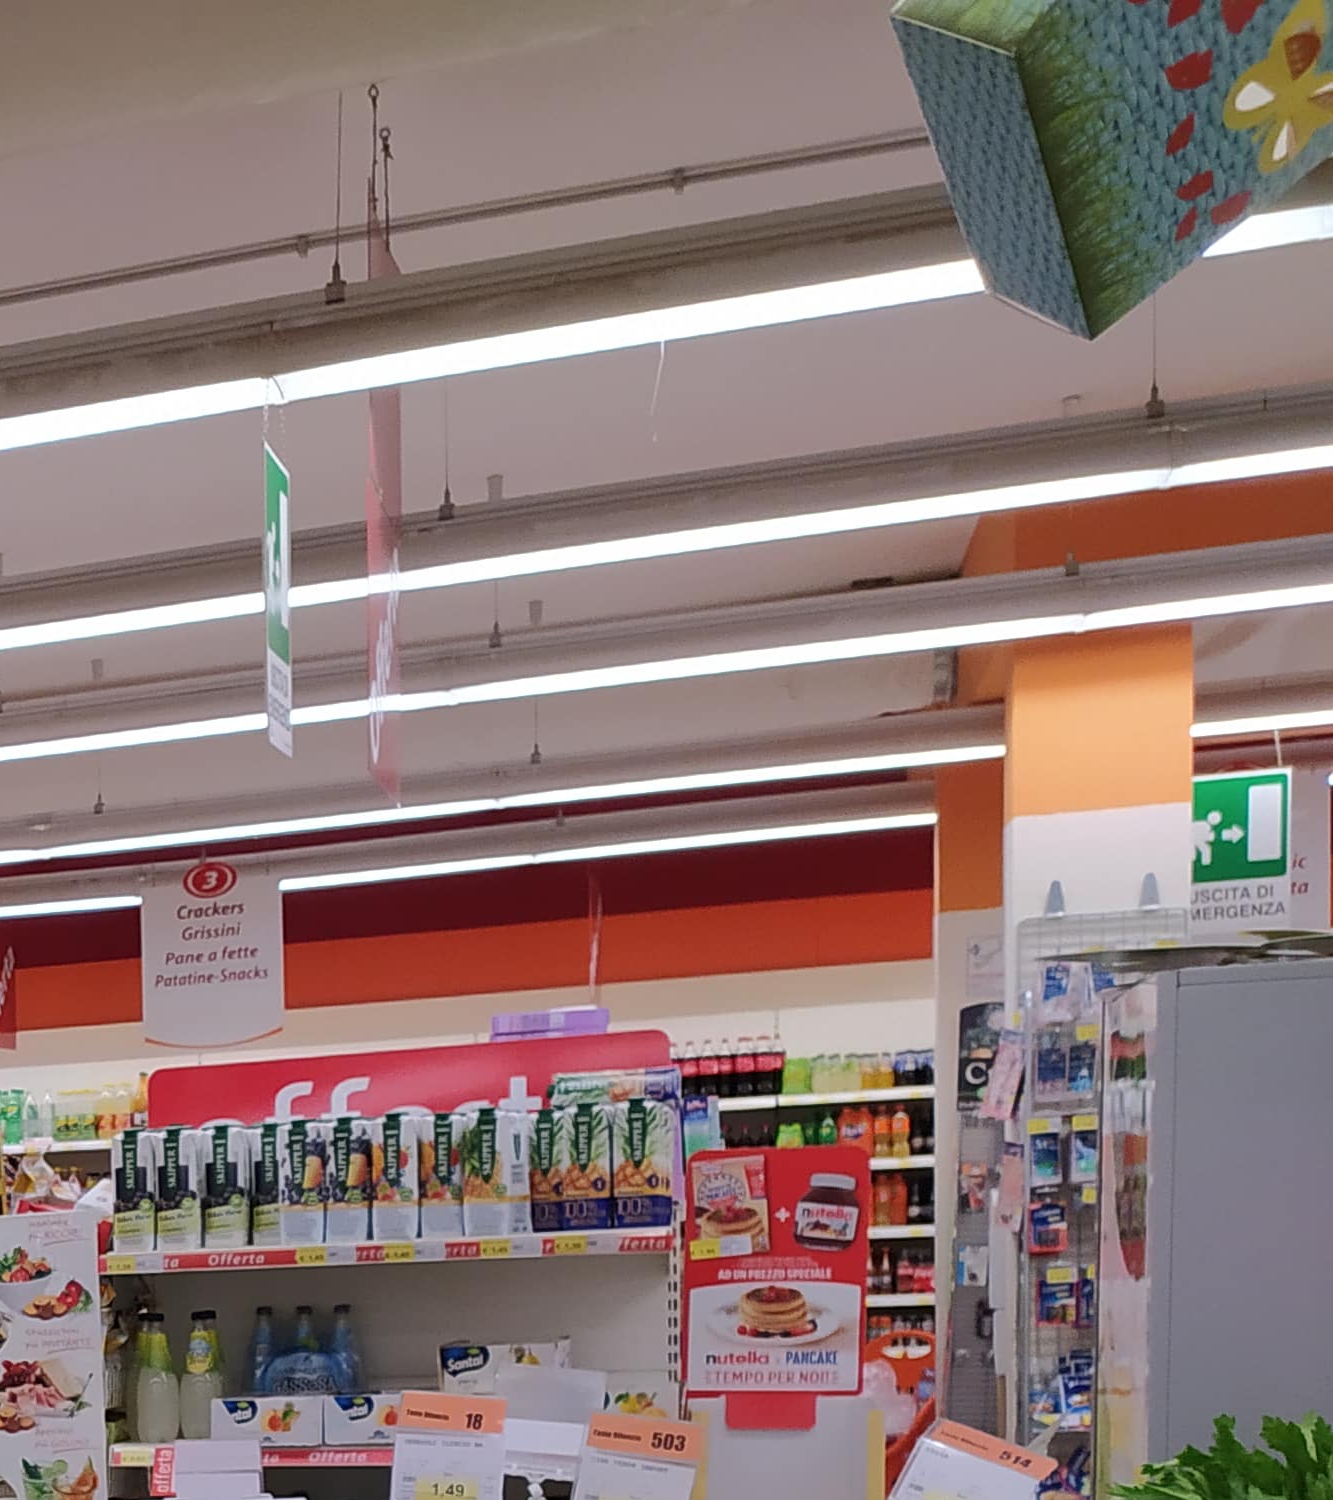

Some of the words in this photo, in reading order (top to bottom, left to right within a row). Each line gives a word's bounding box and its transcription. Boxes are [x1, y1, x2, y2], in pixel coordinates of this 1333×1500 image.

[201, 871, 219, 890] 3
[1257, 885, 1274, 898] DI
[176, 902, 244, 919] Crackers
[1191, 902, 1285, 920] MERGENZA
[181, 922, 241, 941] Grissini
[165, 952, 204, 965] Pane
[208, 951, 217, 961] a
[222, 946, 258, 960] fette
[154, 966, 269, 988] Patatine-Snacks
[208, 1254, 266, 1266] Offerta
[447, 1352, 483, 1373] Santal
[706, 1350, 770, 1365] nutella
[465, 1413, 484, 1431] 18
[651, 1432, 686, 1452] 503
[308, 1451, 368, 1463] Offerta
[998, 1450, 1032, 1468] 514
[156, 1449, 173, 1494] offerta
